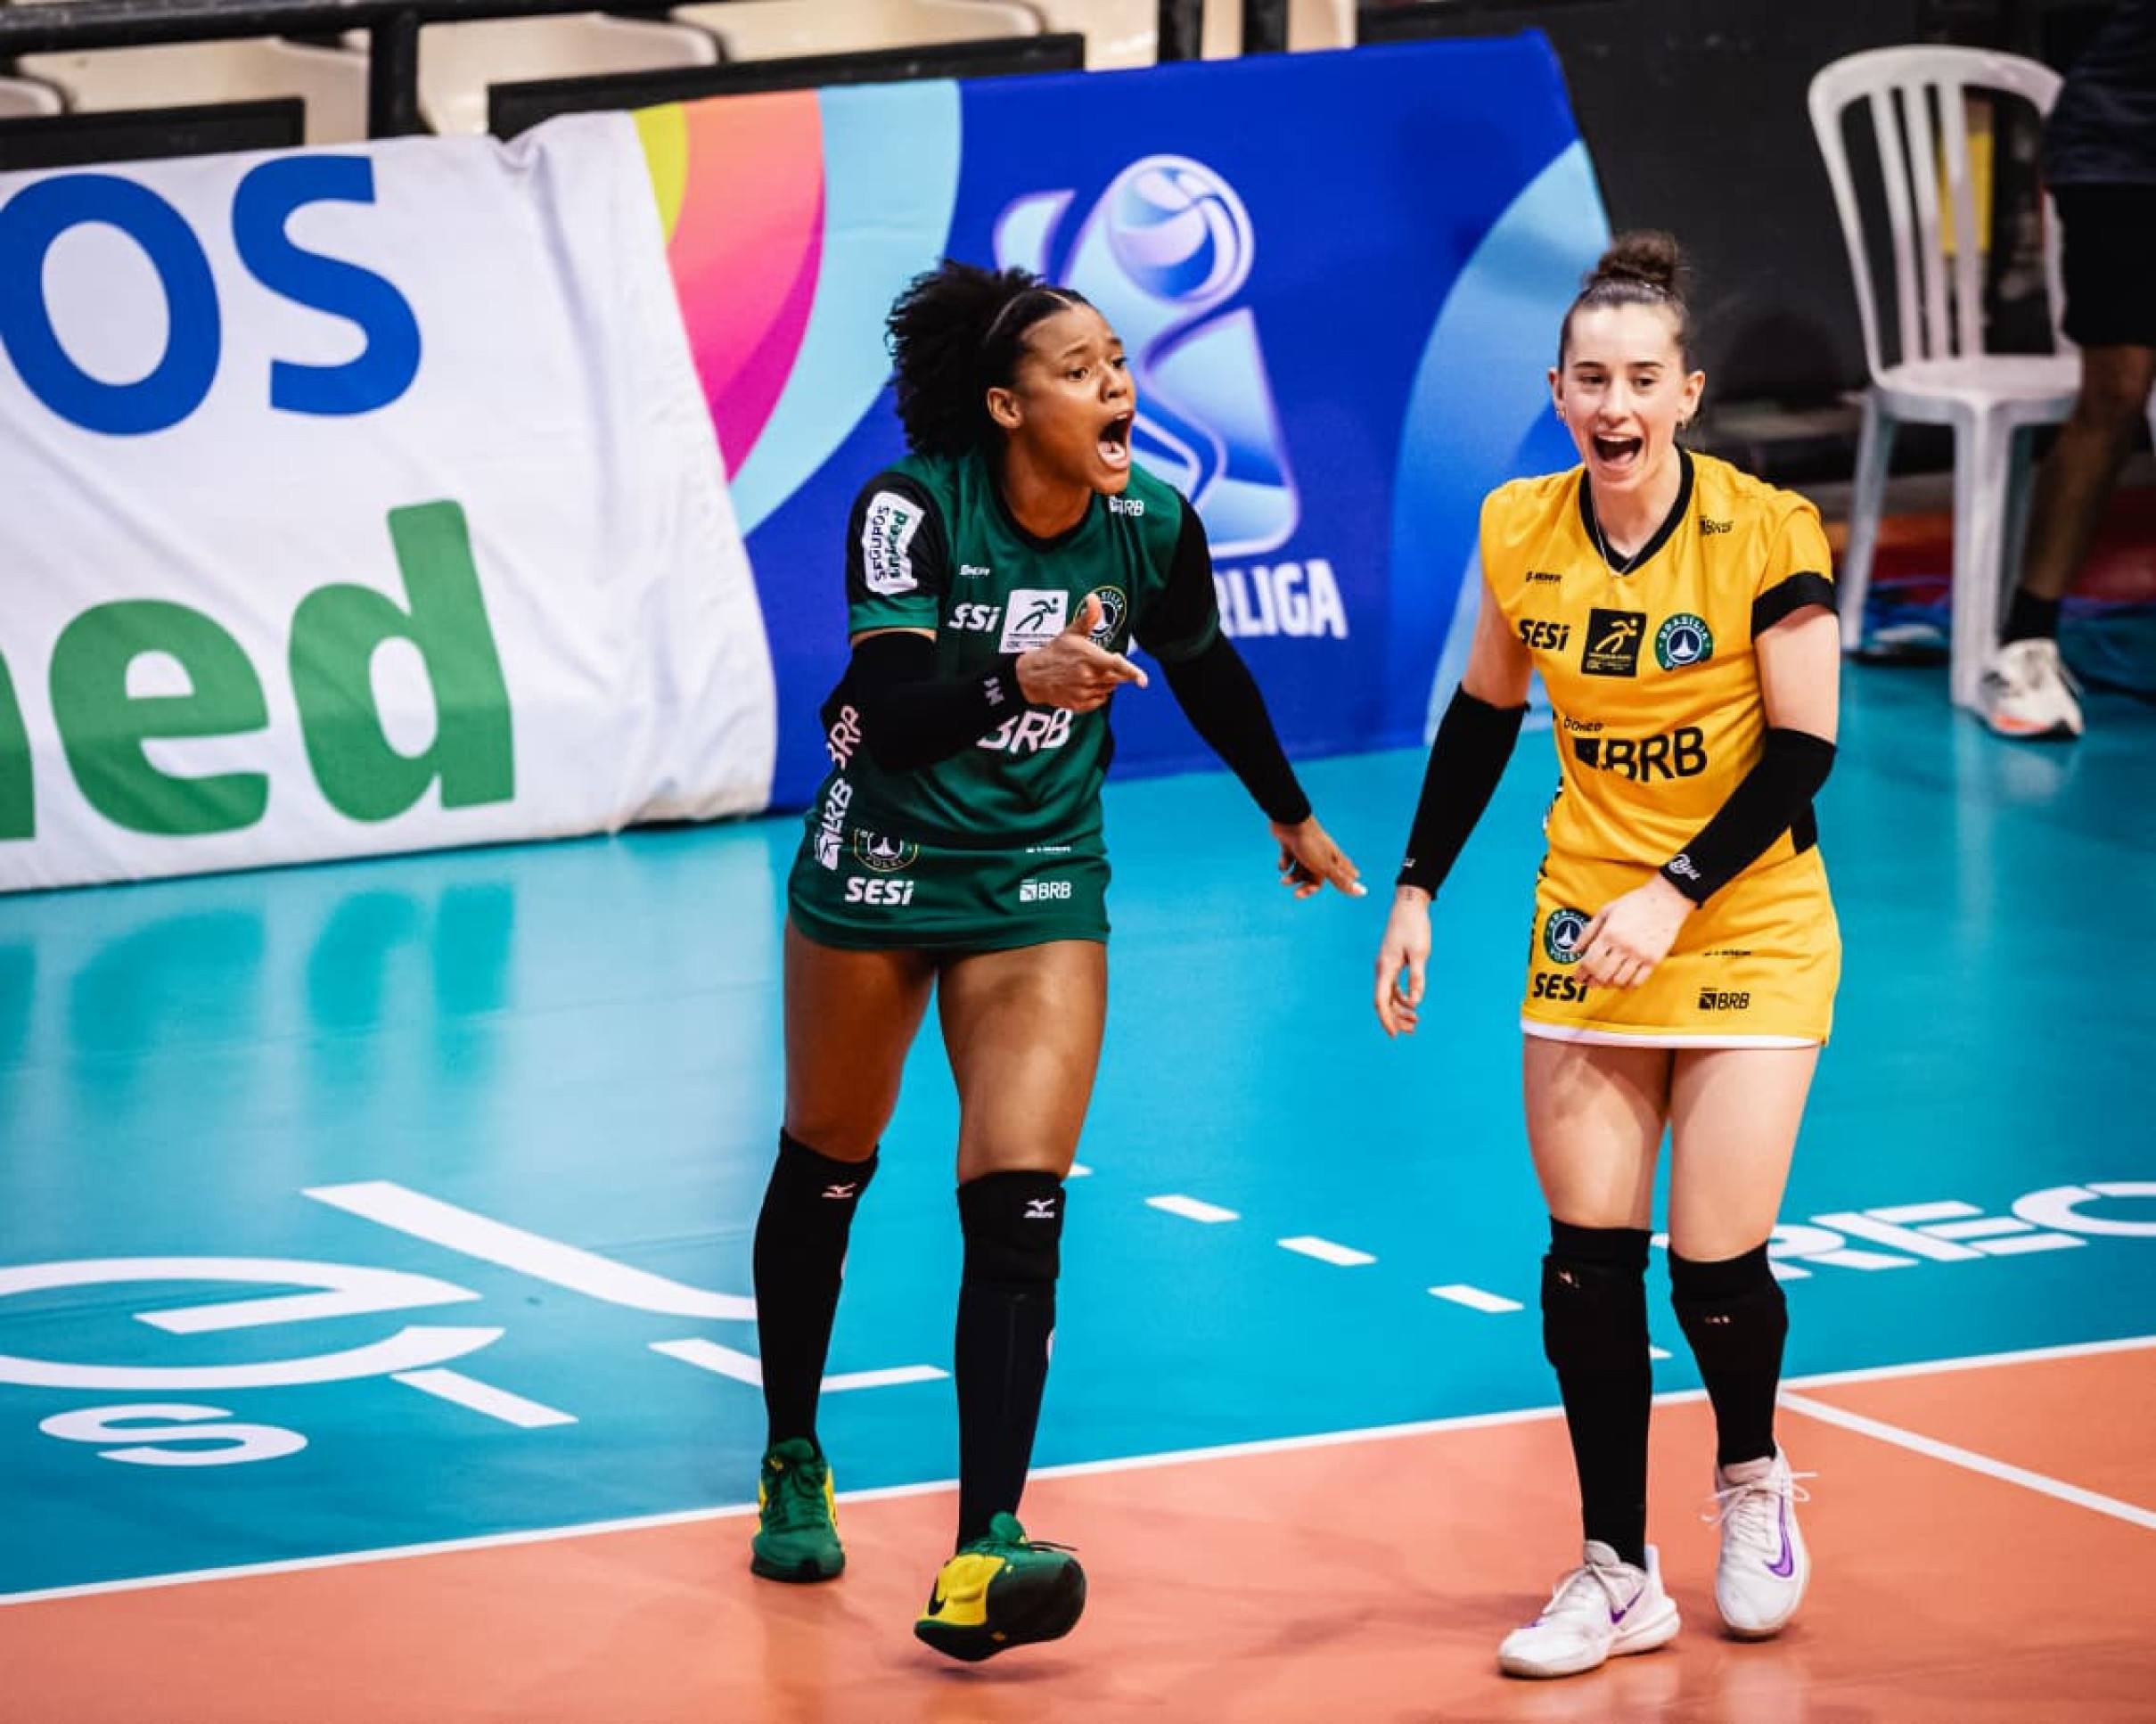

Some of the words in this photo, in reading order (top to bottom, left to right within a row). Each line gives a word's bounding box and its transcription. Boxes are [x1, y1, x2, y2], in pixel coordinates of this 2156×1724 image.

[0, 154, 422, 436] OS
[1602, 727, 1709, 783] BRB
[1038, 881, 1071, 899] BRB
[1717, 992, 1750, 1011] BRB
